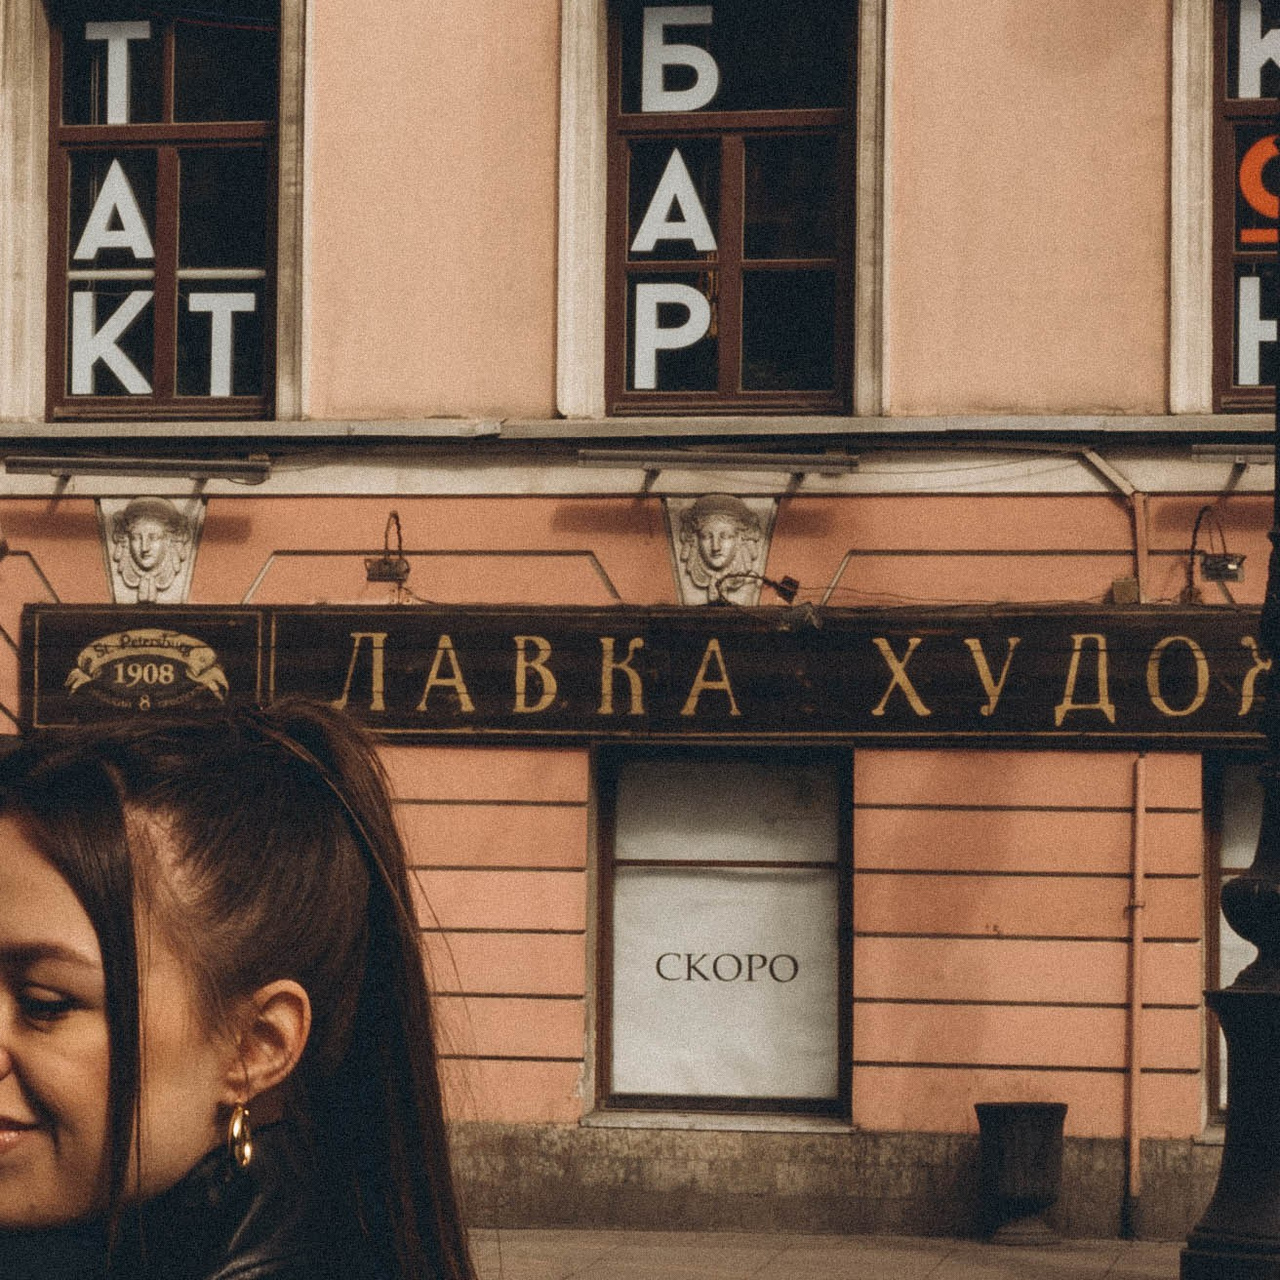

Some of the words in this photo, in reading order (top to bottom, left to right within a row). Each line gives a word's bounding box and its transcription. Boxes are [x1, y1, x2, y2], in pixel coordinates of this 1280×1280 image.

[630, 6, 720, 390] БАР
[113, 663, 175, 688] 1908
[330, 631, 741, 717] ЛАВКА
[656, 952, 799, 983] СКОРО
